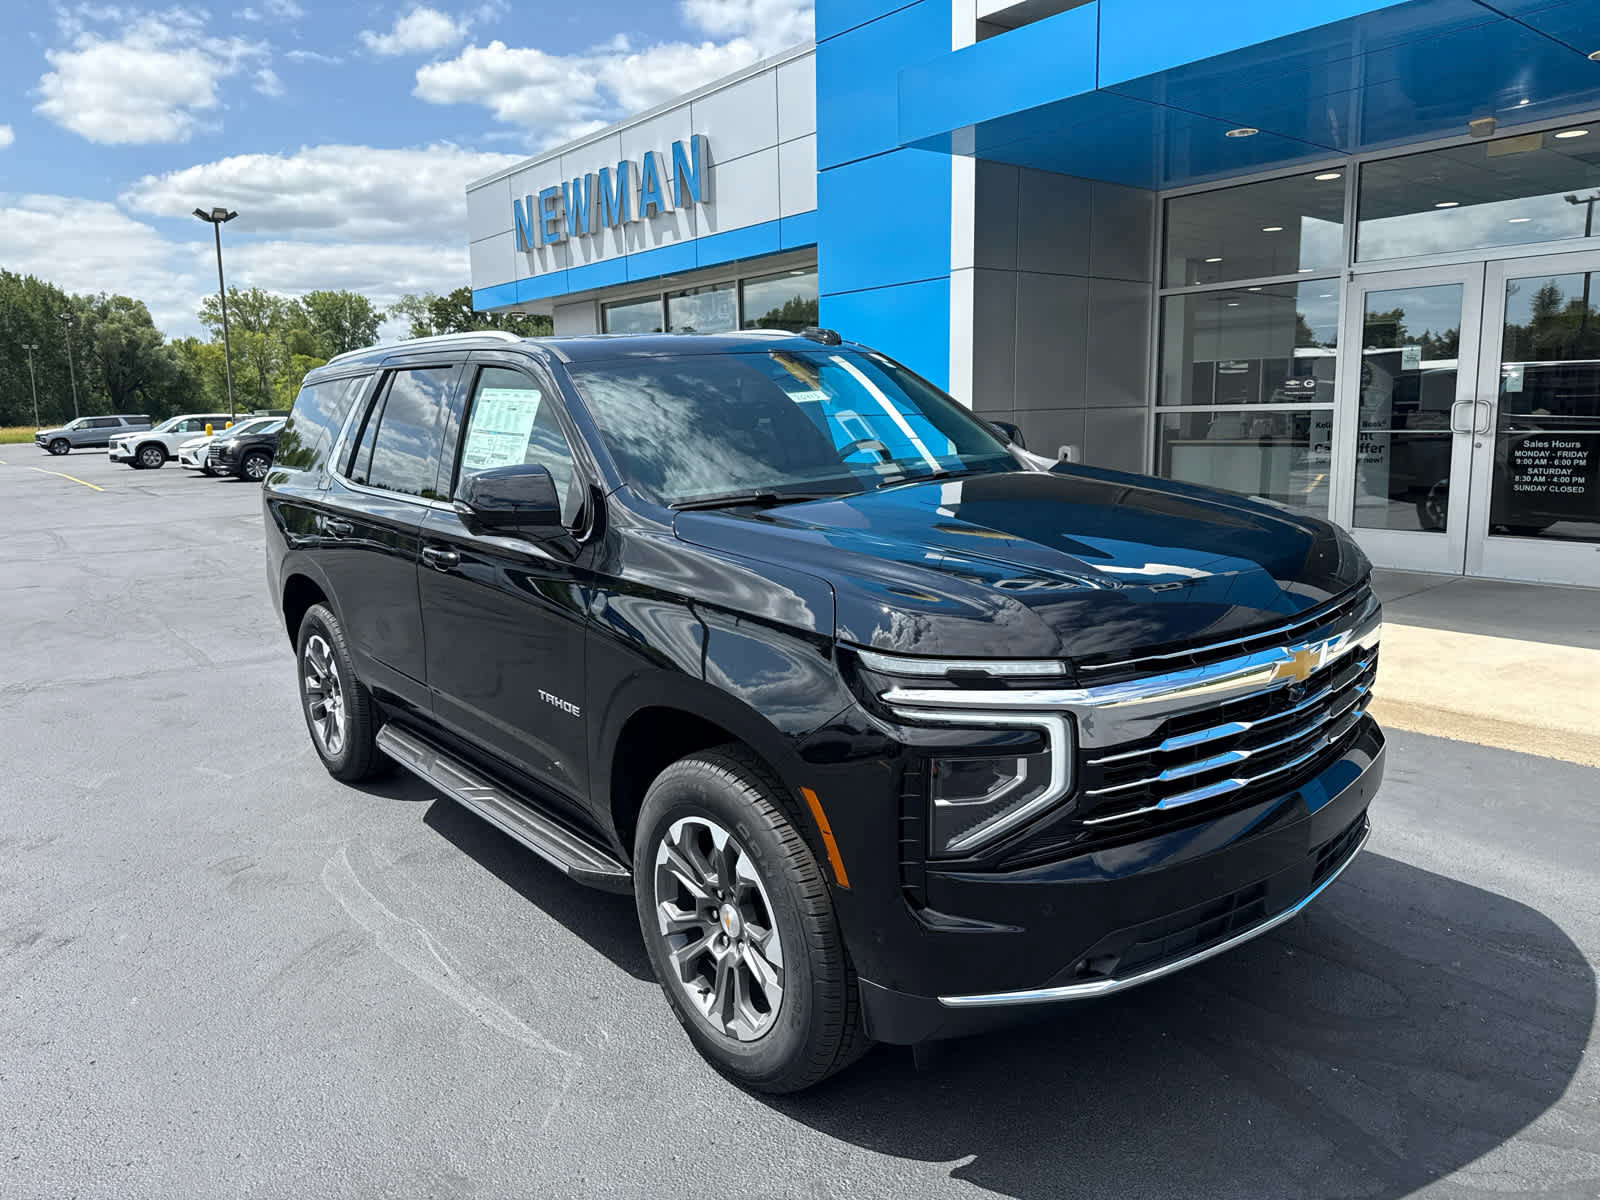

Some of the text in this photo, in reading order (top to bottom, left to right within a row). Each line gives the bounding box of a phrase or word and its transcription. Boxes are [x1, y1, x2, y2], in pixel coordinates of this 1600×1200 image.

[514, 134, 708, 253] NEWMAN
[1359, 442, 1384, 453] ffer
[1523, 440, 1581, 448] Sales Hours
[1513, 484, 1585, 493] SUNDAY CLOSED
[538, 689, 580, 717] TAHOE
